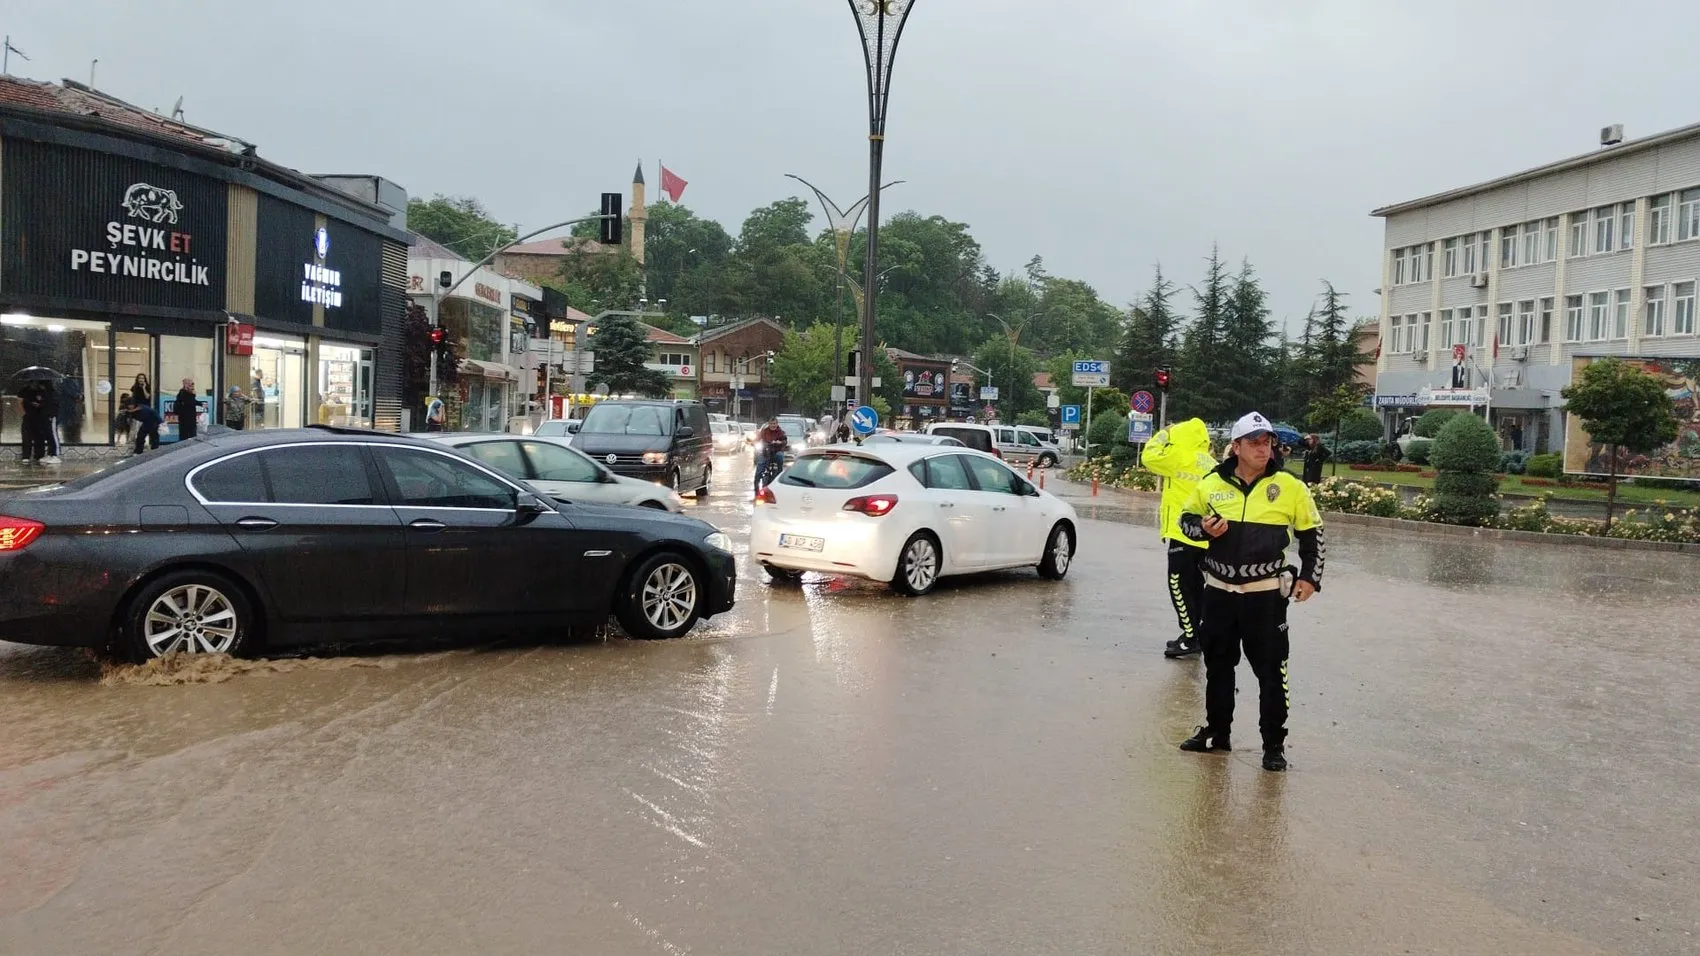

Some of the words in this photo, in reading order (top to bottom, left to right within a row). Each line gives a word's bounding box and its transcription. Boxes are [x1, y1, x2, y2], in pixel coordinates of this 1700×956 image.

[106, 221, 165, 249] ŞEVK
[170, 231, 192, 253] ET
[71, 249, 209, 286] PEYNİRCİLİK
[301, 280, 342, 309] İLETİŞİM
[1075, 362, 1098, 372] EDS
[1065, 406, 1076, 421] P
